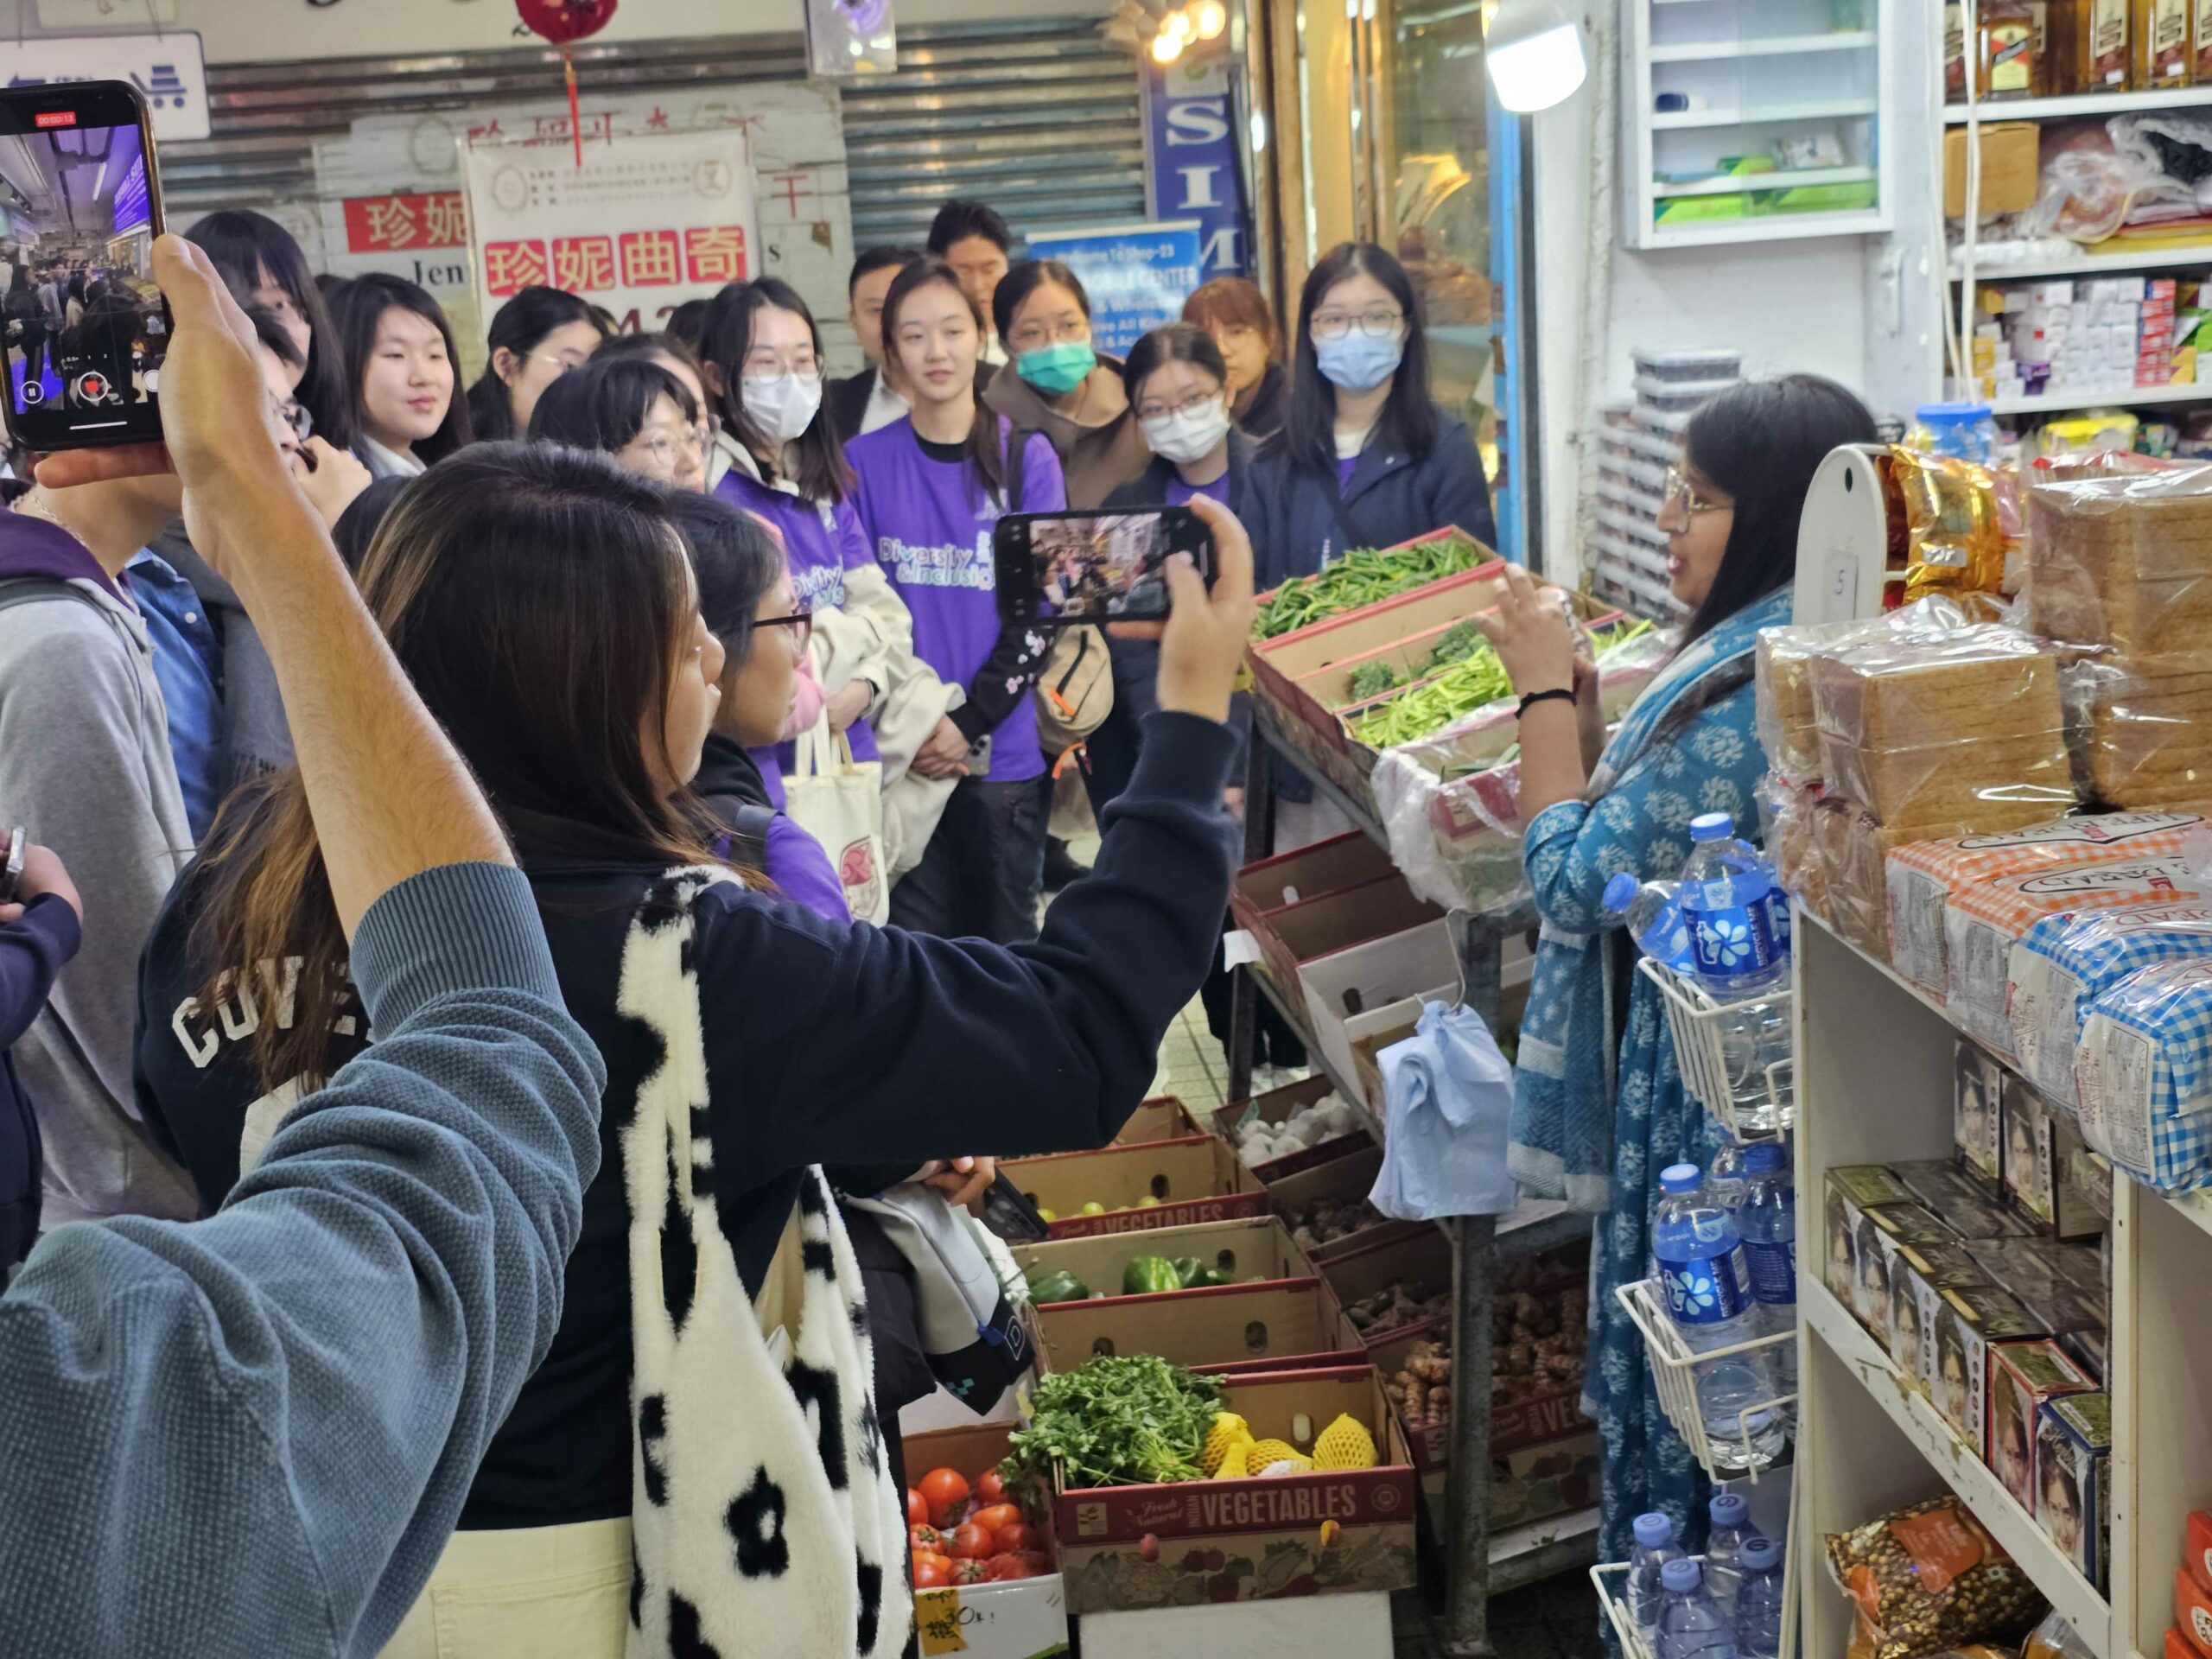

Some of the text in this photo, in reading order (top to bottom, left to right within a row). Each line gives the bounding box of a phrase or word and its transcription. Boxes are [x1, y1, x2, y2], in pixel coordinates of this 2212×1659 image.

[1166, 99, 1242, 270] SIM
[365, 195, 467, 249] 珍妮
[486, 226, 746, 293] 珍妮曲奇
[1141, 266, 1198, 288] CENTER
[878, 537, 974, 571] Diversity
[1202, 1484, 1357, 1527] VEGETABLES
